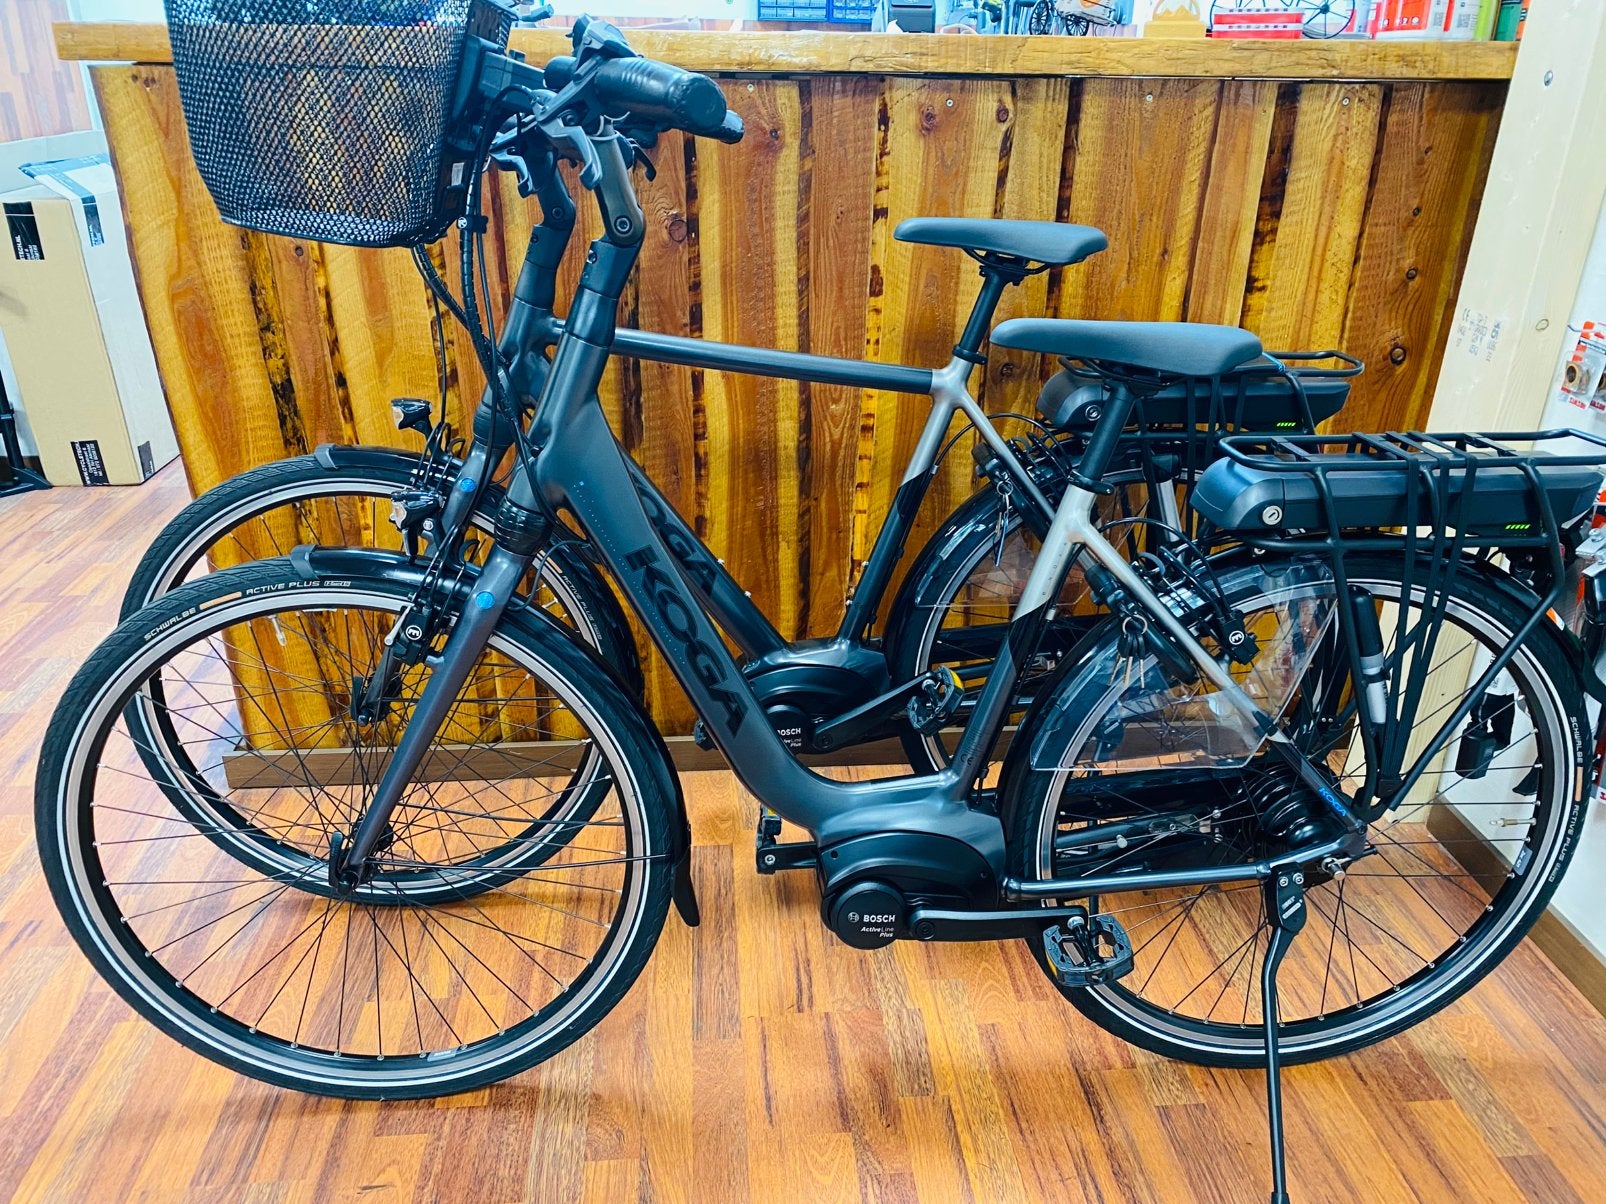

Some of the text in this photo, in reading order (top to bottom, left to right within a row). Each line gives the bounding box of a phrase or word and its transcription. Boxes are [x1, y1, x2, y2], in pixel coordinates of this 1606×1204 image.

[630, 473, 719, 597] OGA
[246, 582, 285, 595] ACTIVE
[288, 580, 321, 588] PLUS
[562, 575, 595, 621] ACTIVE PLUS
[143, 606, 197, 642] SCHWALBE
[624, 544, 749, 739] KOGA
[1569, 716, 1584, 764] SCHWALBE
[1318, 787, 1347, 817] KOGA
[1558, 804, 1580, 862] ACTIVE PLUS
[863, 914, 896, 923] BOSCH
